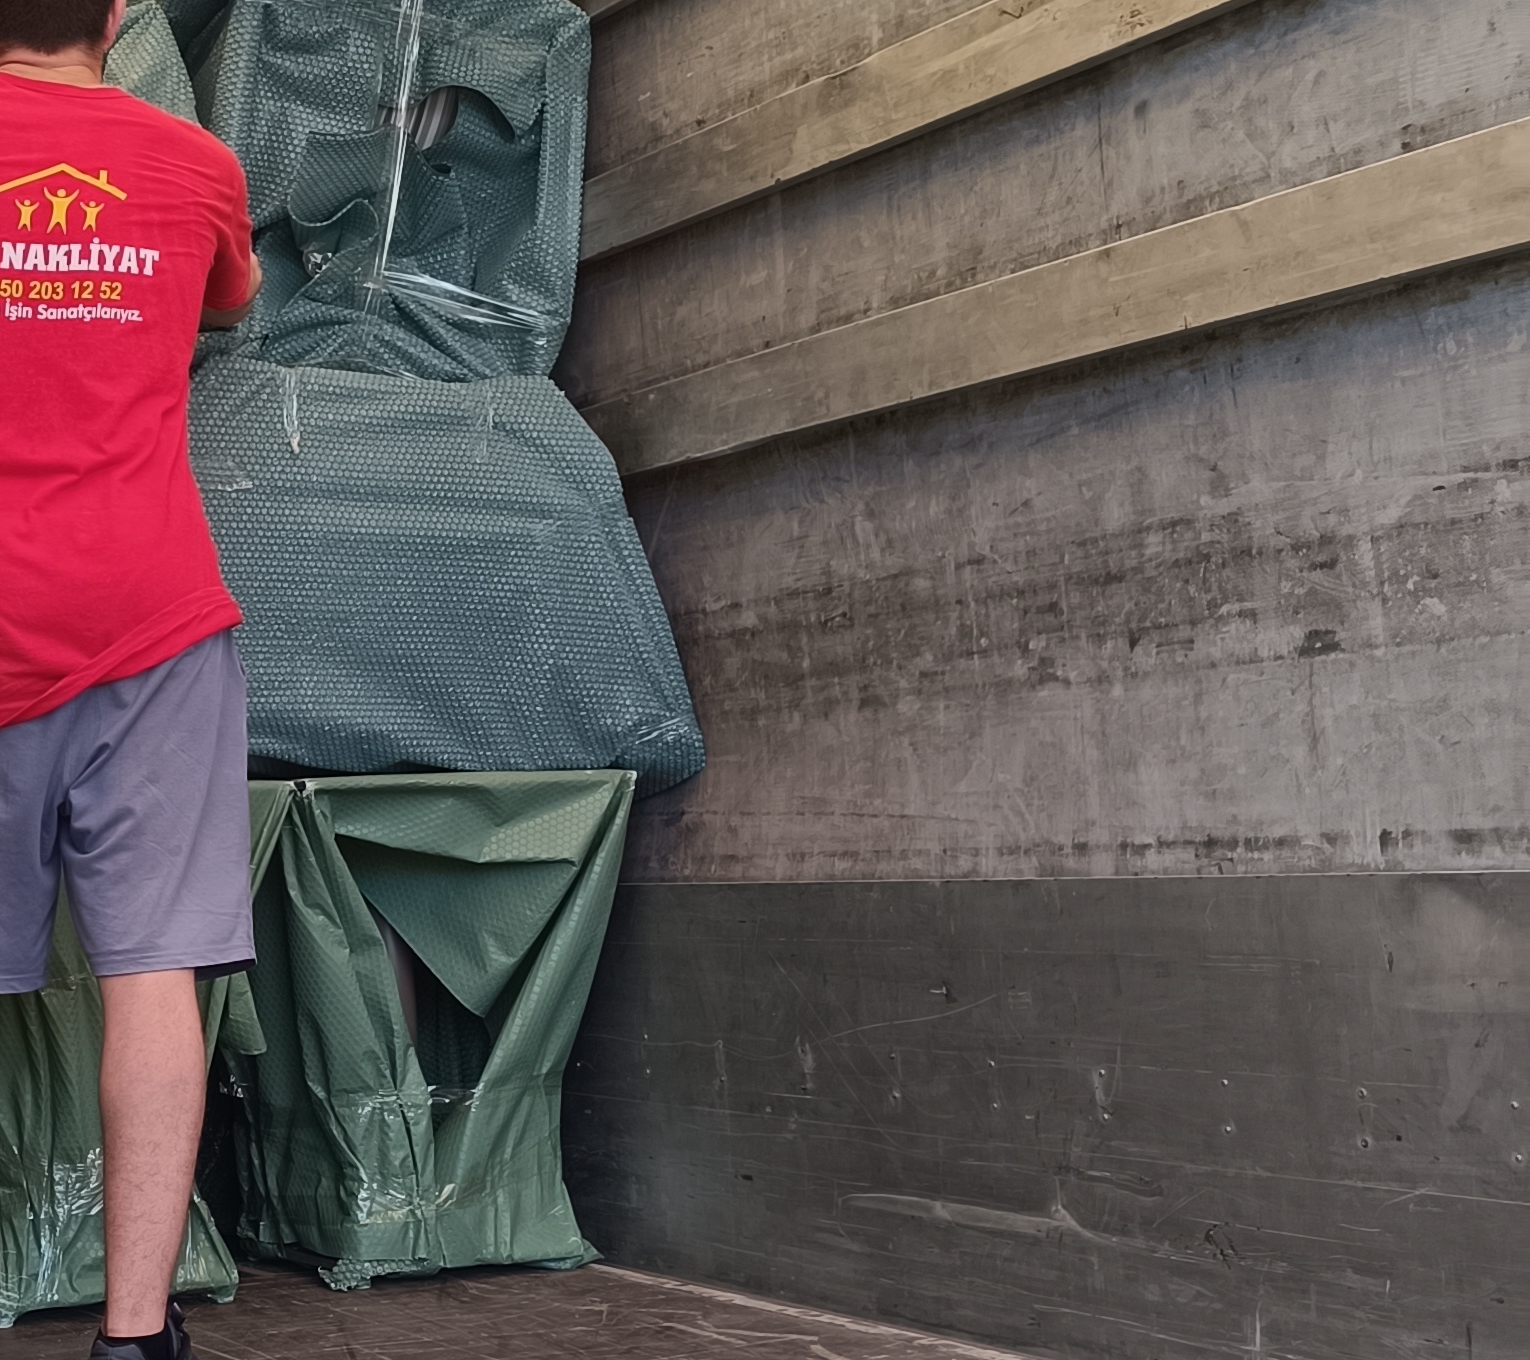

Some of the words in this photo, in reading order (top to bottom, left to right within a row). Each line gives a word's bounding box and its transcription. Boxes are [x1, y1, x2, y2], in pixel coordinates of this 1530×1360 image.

[0, 237, 160, 276] NAKLİYAT
[28, 281, 64, 300] 203
[71, 281, 94, 300] 12
[99, 282, 123, 300] 52
[4, 298, 33, 321] İşin
